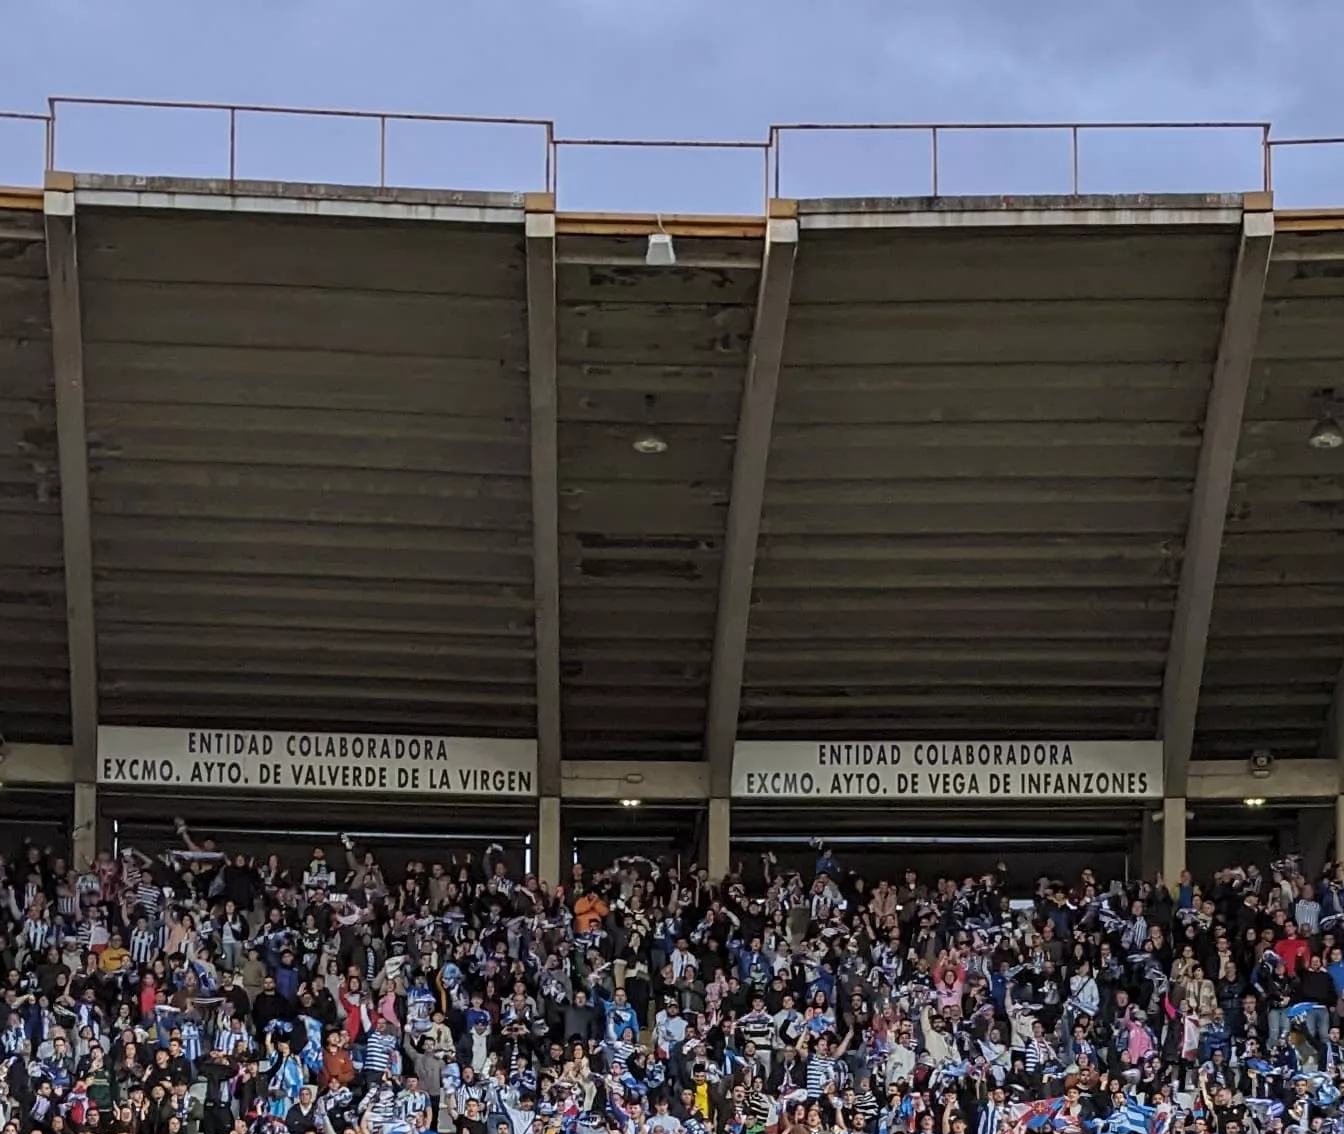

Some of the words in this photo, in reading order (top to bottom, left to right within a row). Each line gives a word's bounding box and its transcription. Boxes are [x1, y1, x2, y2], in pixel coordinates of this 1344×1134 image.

[188, 732, 273, 755] ENTIDAD
[287, 735, 448, 760] COLABORADORA
[819, 744, 901, 765] ENTIDAD
[914, 744, 1073, 765] COLABORADORA
[103, 759, 181, 782] EXCMO.
[190, 761, 249, 784] AYTO.
[259, 763, 281, 785] DE
[291, 764, 387, 788] VALVERDE
[398, 767, 419, 789] DE
[429, 768, 450, 790] LA
[459, 769, 532, 792] VIRGEN
[747, 772, 821, 794] EXCMO.
[830, 772, 887, 794] AYTO.
[897, 772, 918, 794] DE
[928, 772, 980, 794] VEGA
[990, 772, 1010, 794] DE
[1021, 772, 1148, 794] INFANZONES
